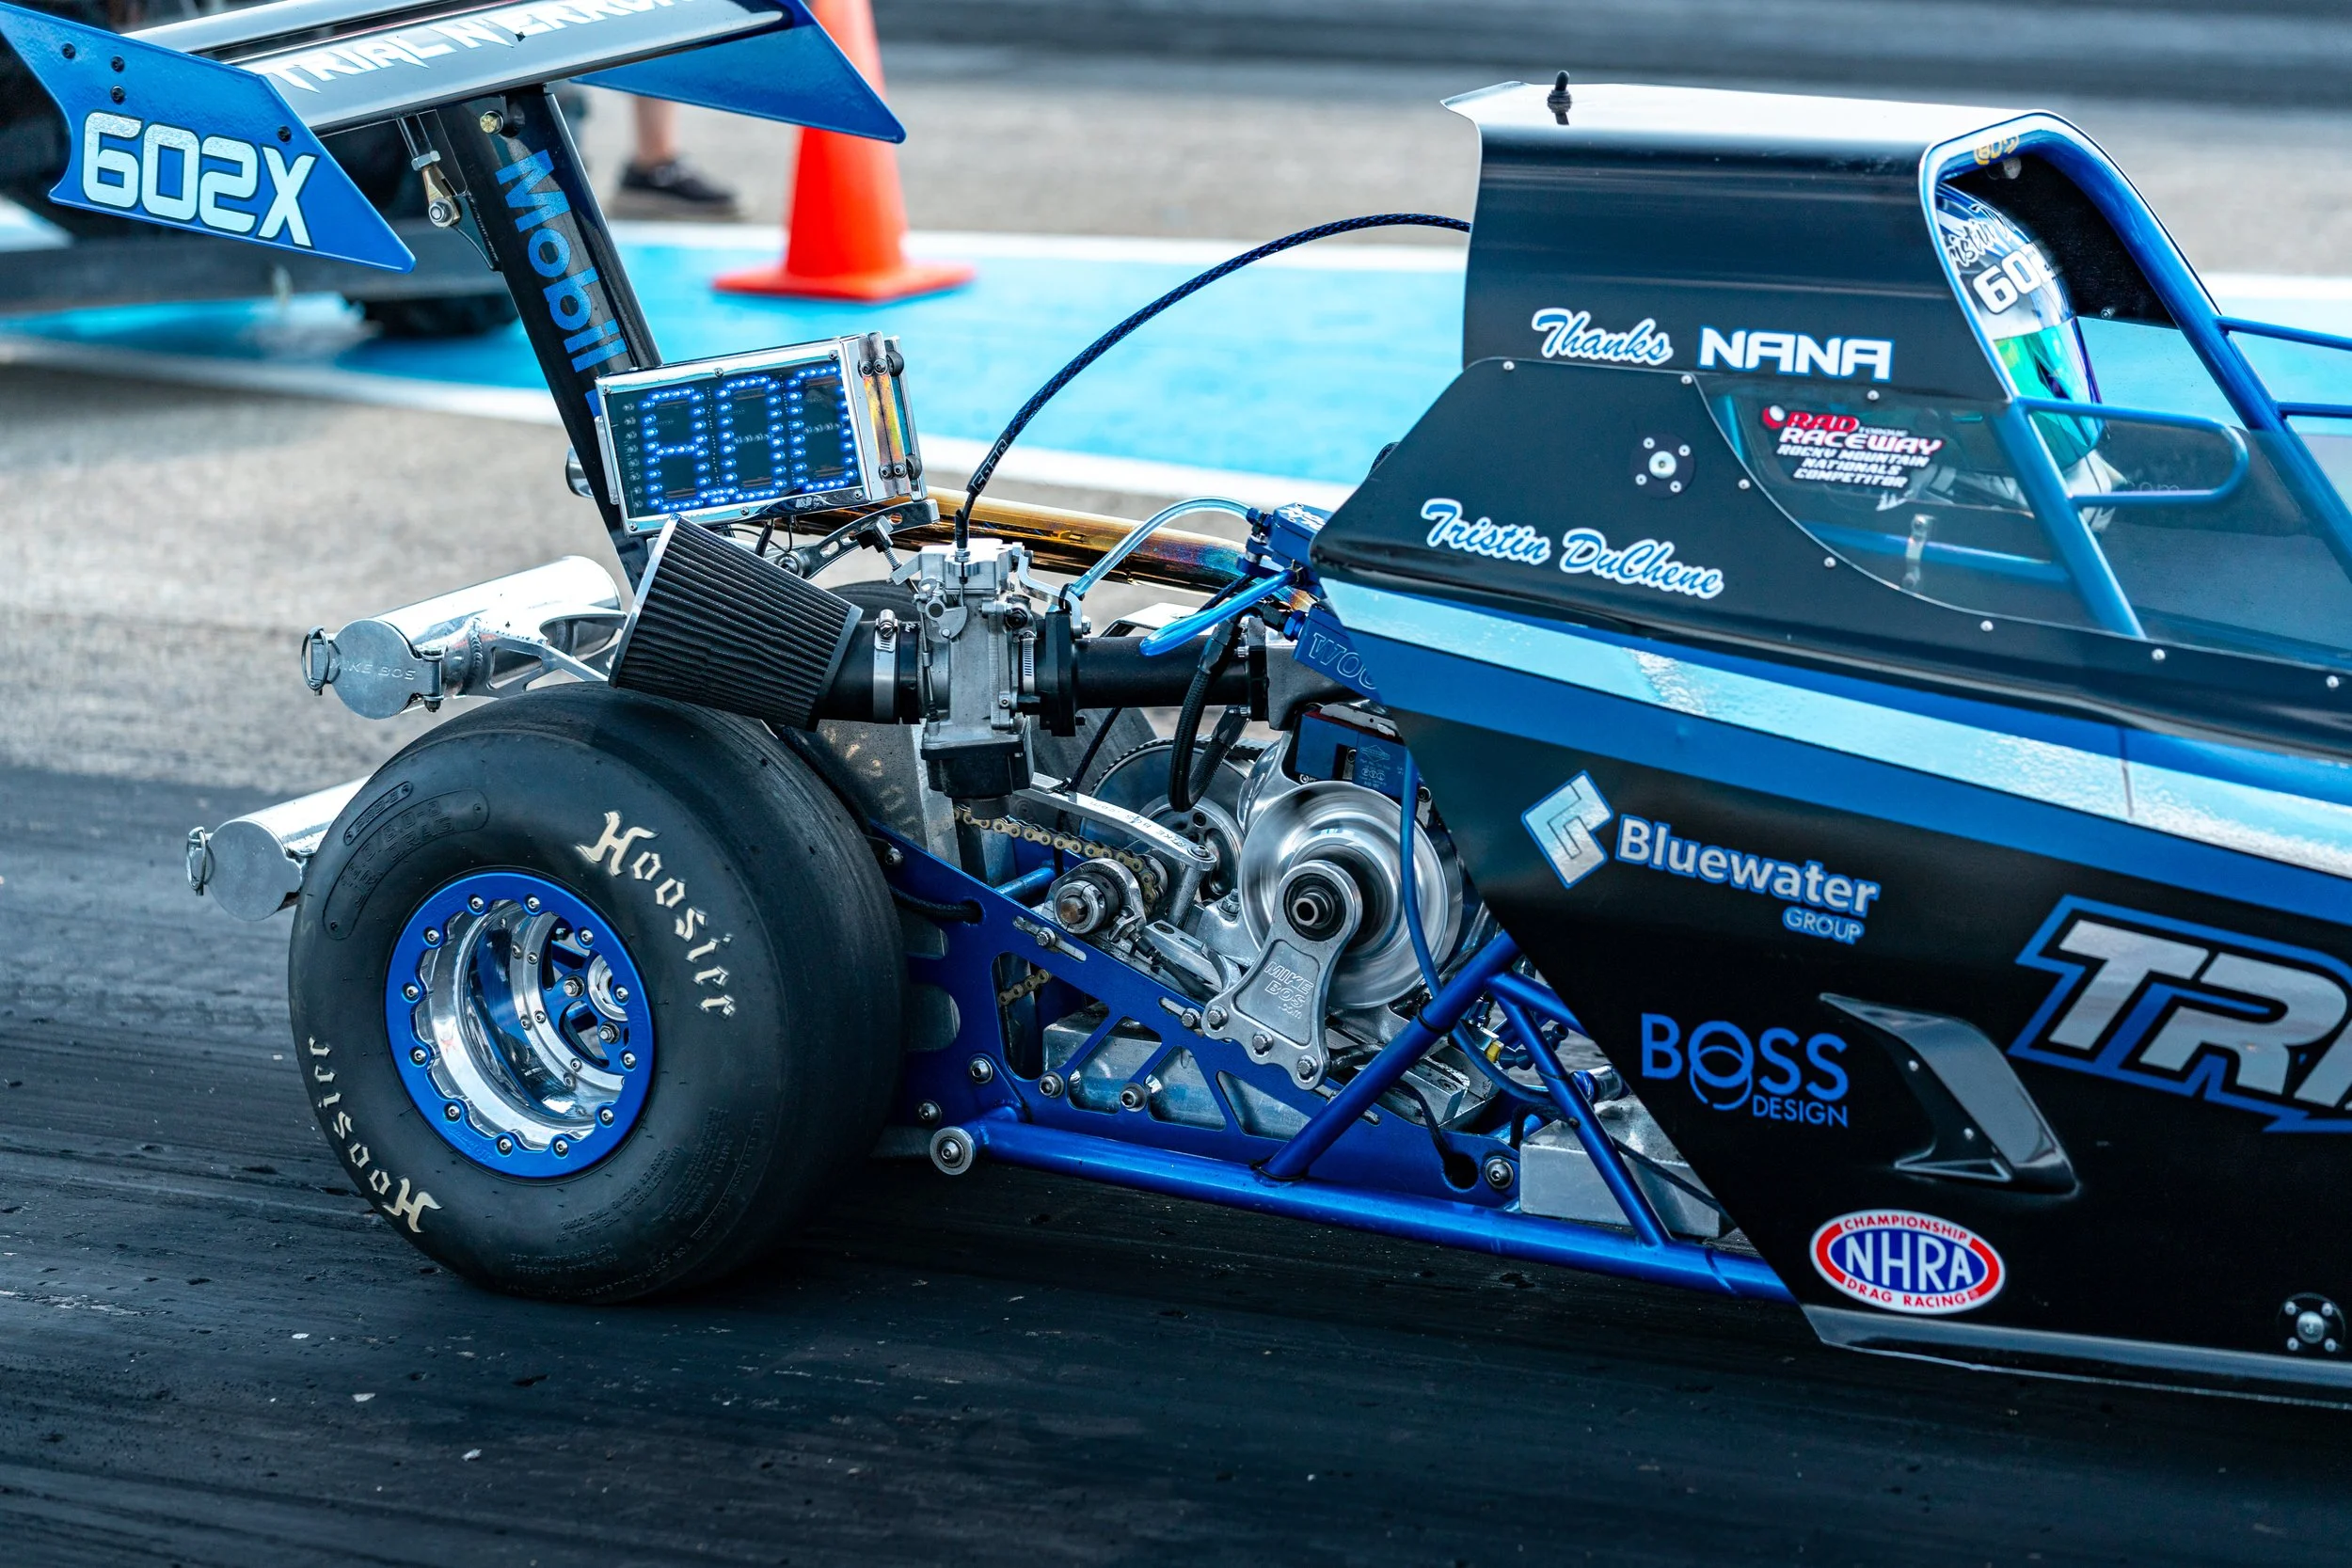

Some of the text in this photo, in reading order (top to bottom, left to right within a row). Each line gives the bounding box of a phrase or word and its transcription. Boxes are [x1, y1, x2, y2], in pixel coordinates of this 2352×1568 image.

[266, 35, 458, 94] TRIAL
[83, 111, 318, 248] 602X
[495, 150, 628, 373] Mobil
[1532, 306, 1895, 382] Thanks NANA
[1786, 411, 1860, 433] RAD
[1776, 444, 1931, 467] ROCKY MOUNTAIN
[1779, 426, 1943, 456] RACEWAY
[1793, 467, 1909, 488] COMPETITOR
[1802, 457, 1903, 476] NATIONALS
[1421, 498, 1725, 600] Tristin DuChene
[378, 666, 417, 681] BOS
[1615, 814, 1882, 918] Bluewater
[575, 810, 737, 1021] Hoosier
[1782, 905, 1865, 944] GROUP
[1263, 960, 1315, 995] MIKE
[1264, 979, 1307, 1008] BOS
[1641, 1013, 1850, 1106] BOSS
[1753, 1093, 1850, 1129] DESIGN
[309, 1036, 442, 1233] Hoosier
[1844, 1214, 1968, 1242] CHAMPIONSHIP
[1844, 1230, 1975, 1292] NHRA
[1847, 1277, 1894, 1303] DRAG
[1902, 1291, 1967, 1308] RACING
